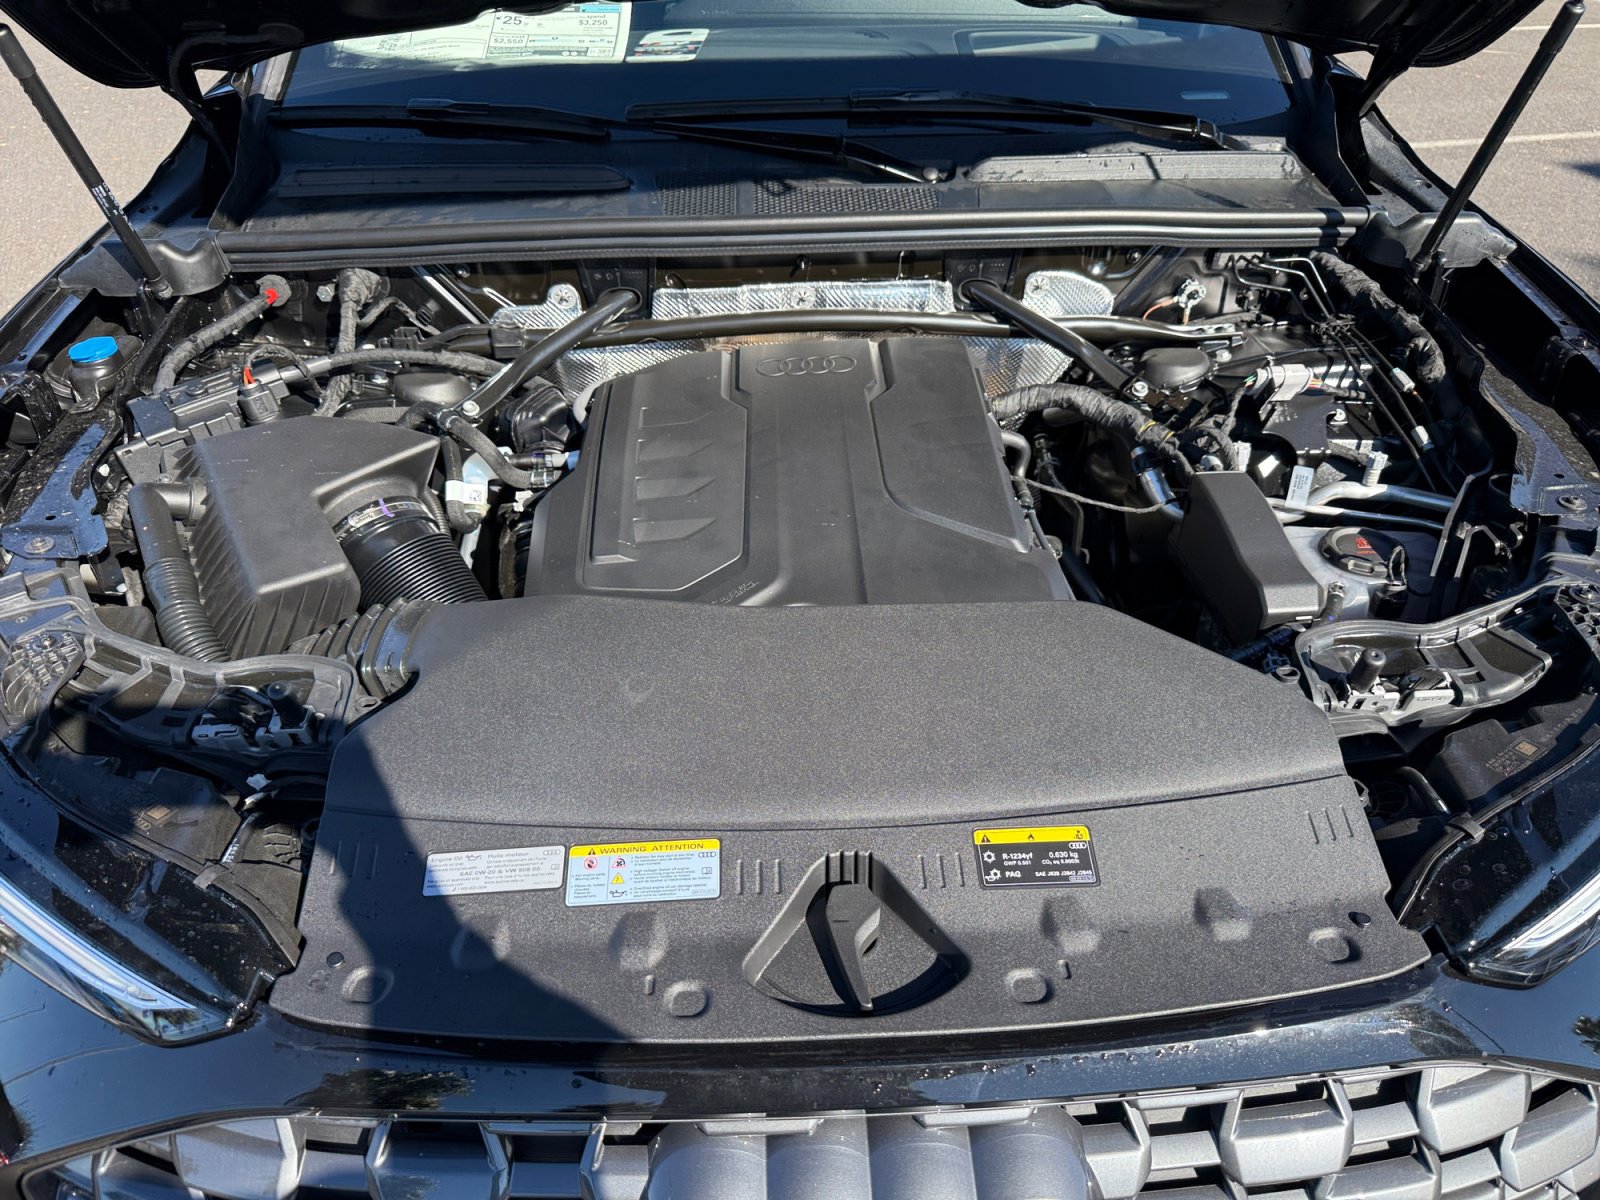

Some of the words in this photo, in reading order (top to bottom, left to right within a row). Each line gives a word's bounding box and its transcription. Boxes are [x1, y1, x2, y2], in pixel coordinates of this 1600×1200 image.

[503, 15, 522, 25] 25
[600, 846, 647, 855] WARNING
[651, 843, 704, 852] ATTENTION
[1002, 851, 1033, 861] R-1234yf
[1069, 851, 1079, 859] kg
[1005, 870, 1021, 878] PAG
